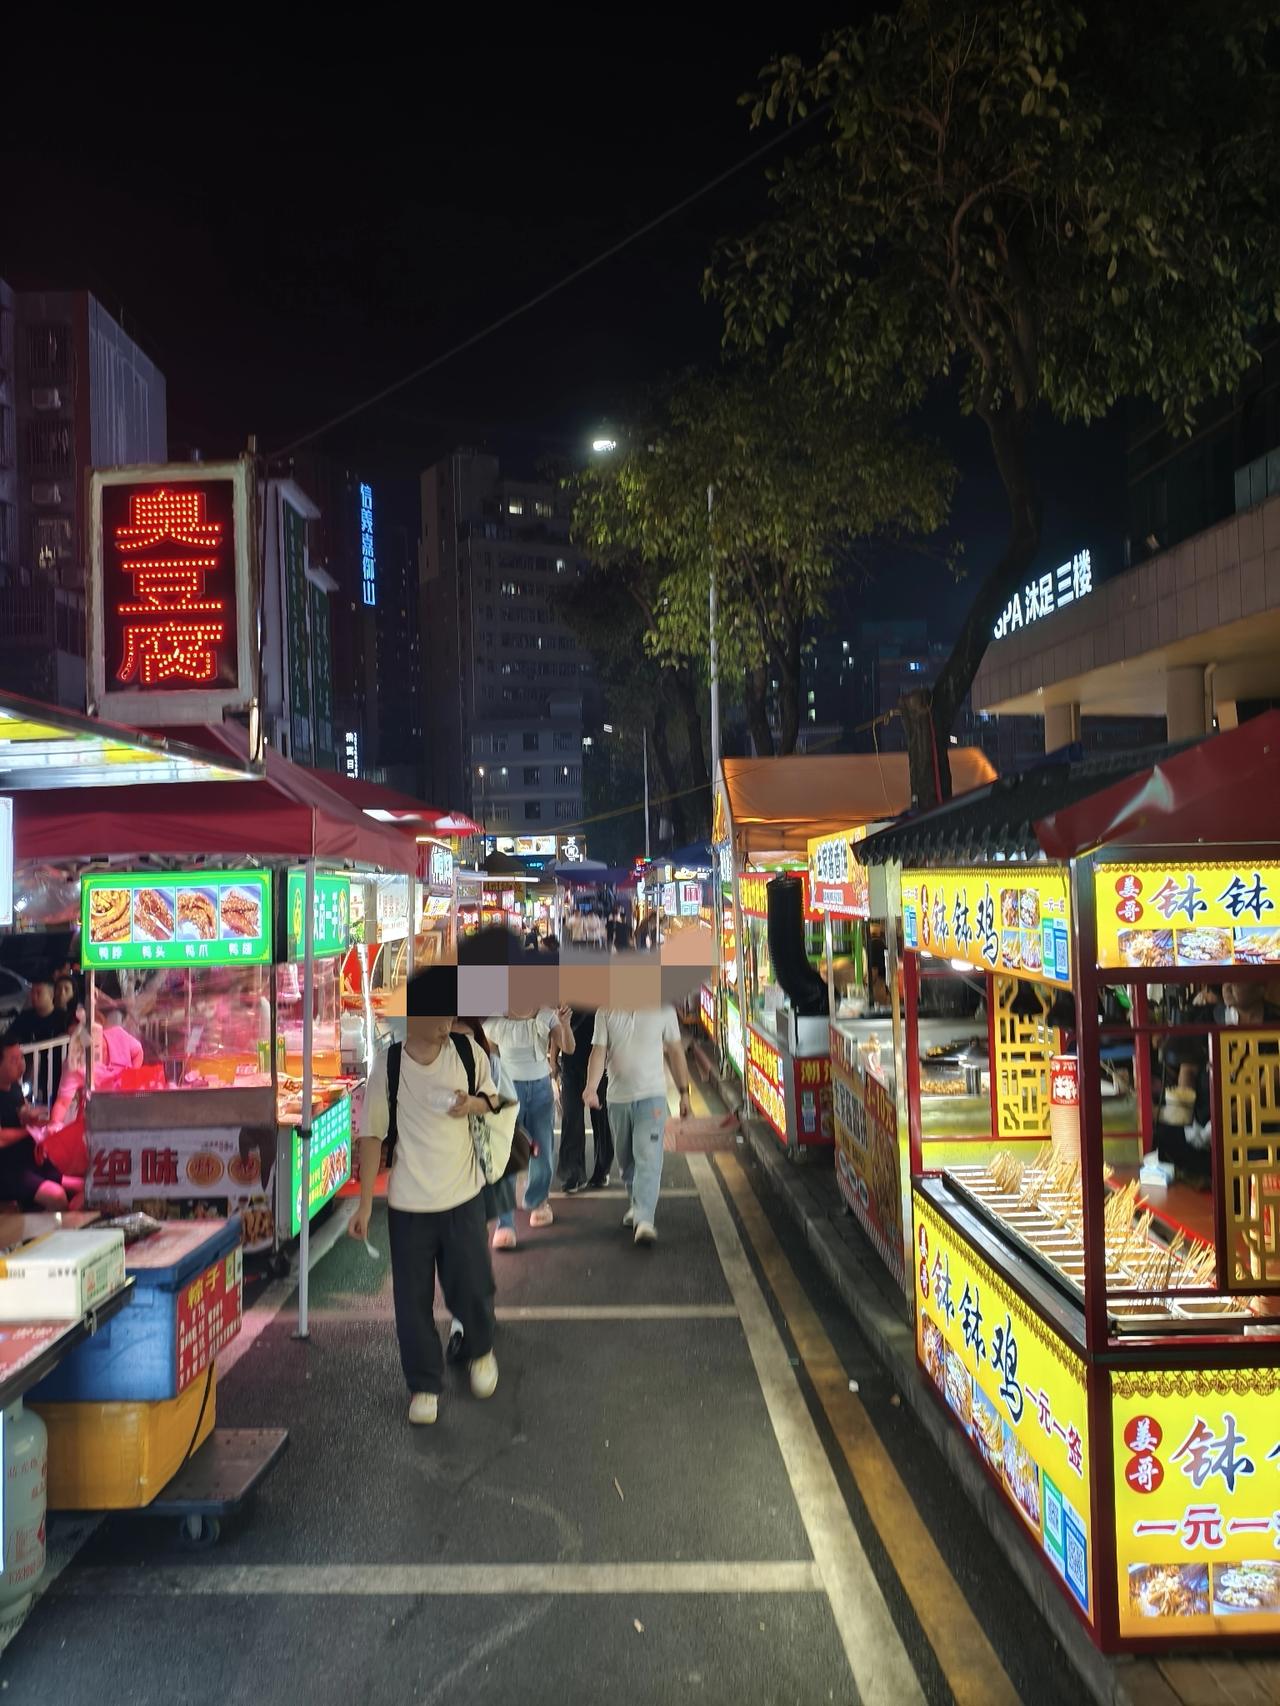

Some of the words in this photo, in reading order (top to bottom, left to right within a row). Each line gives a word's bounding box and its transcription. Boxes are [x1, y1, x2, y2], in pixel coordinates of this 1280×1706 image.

[115, 488, 224, 685] 臭豆腐
[932, 883, 999, 964] 钵钵鸡
[1117, 875, 1141, 922] 姜哥
[1149, 873, 1275, 922] 钵钵
[142, 944, 166, 959] 鸭头
[185, 943, 209, 958] 鸭爪
[93, 1148, 179, 1187] 绝味
[932, 1250, 1025, 1424] 钵钵鸡
[1025, 1385, 1083, 1477] 一元一签
[1128, 1417, 1159, 1492] 姜哥
[1170, 1414, 1280, 1493] 钵
[1136, 1508, 1280, 1546] 一元一
